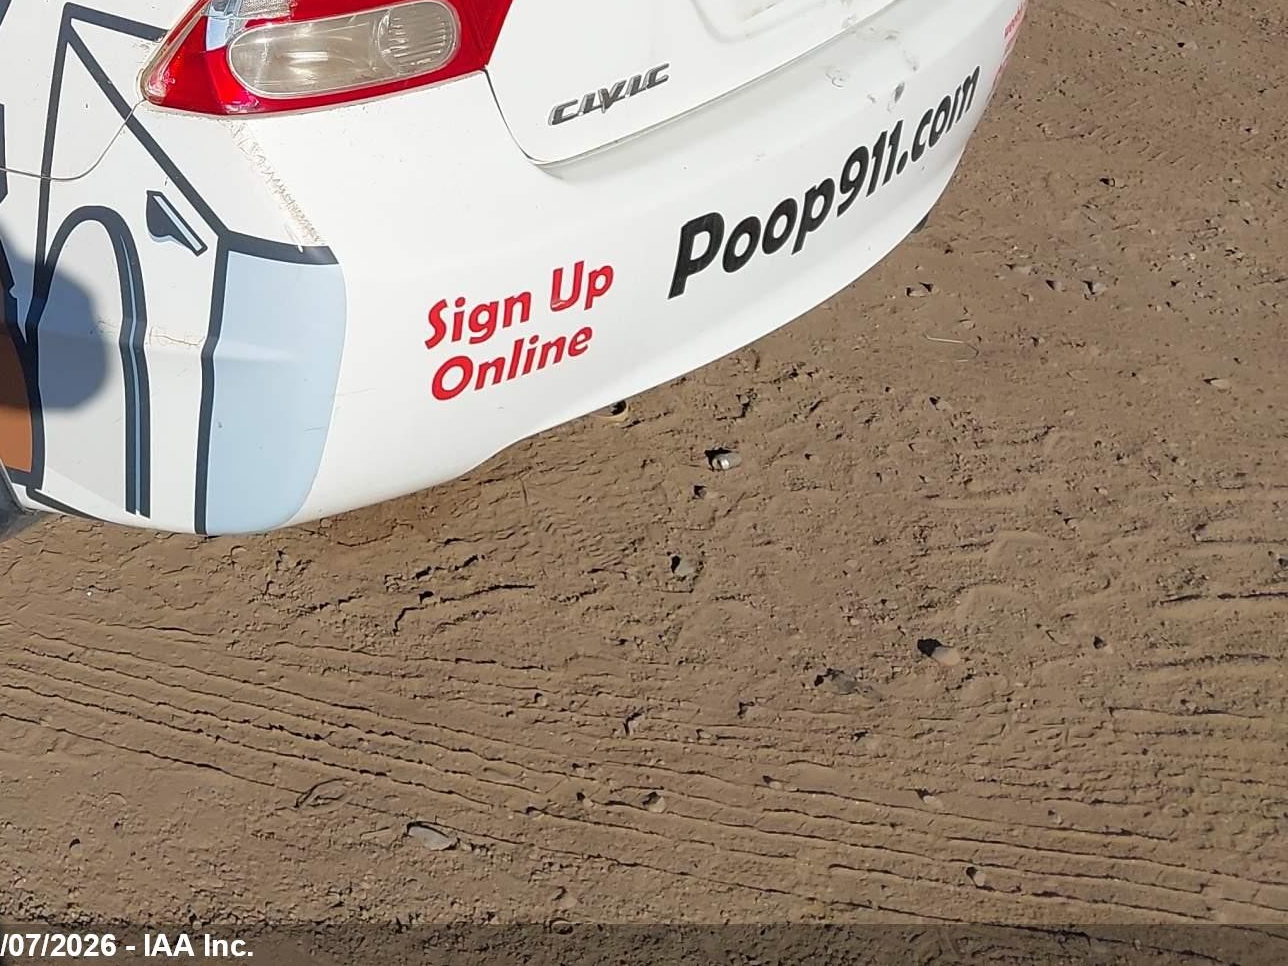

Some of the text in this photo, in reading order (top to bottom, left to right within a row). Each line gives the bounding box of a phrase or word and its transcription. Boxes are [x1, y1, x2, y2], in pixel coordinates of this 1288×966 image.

[548, 63, 670, 126] CIVIC
[668, 65, 981, 299] Poop911.com
[425, 261, 614, 350] Sign Up
[431, 326, 594, 401] Online
